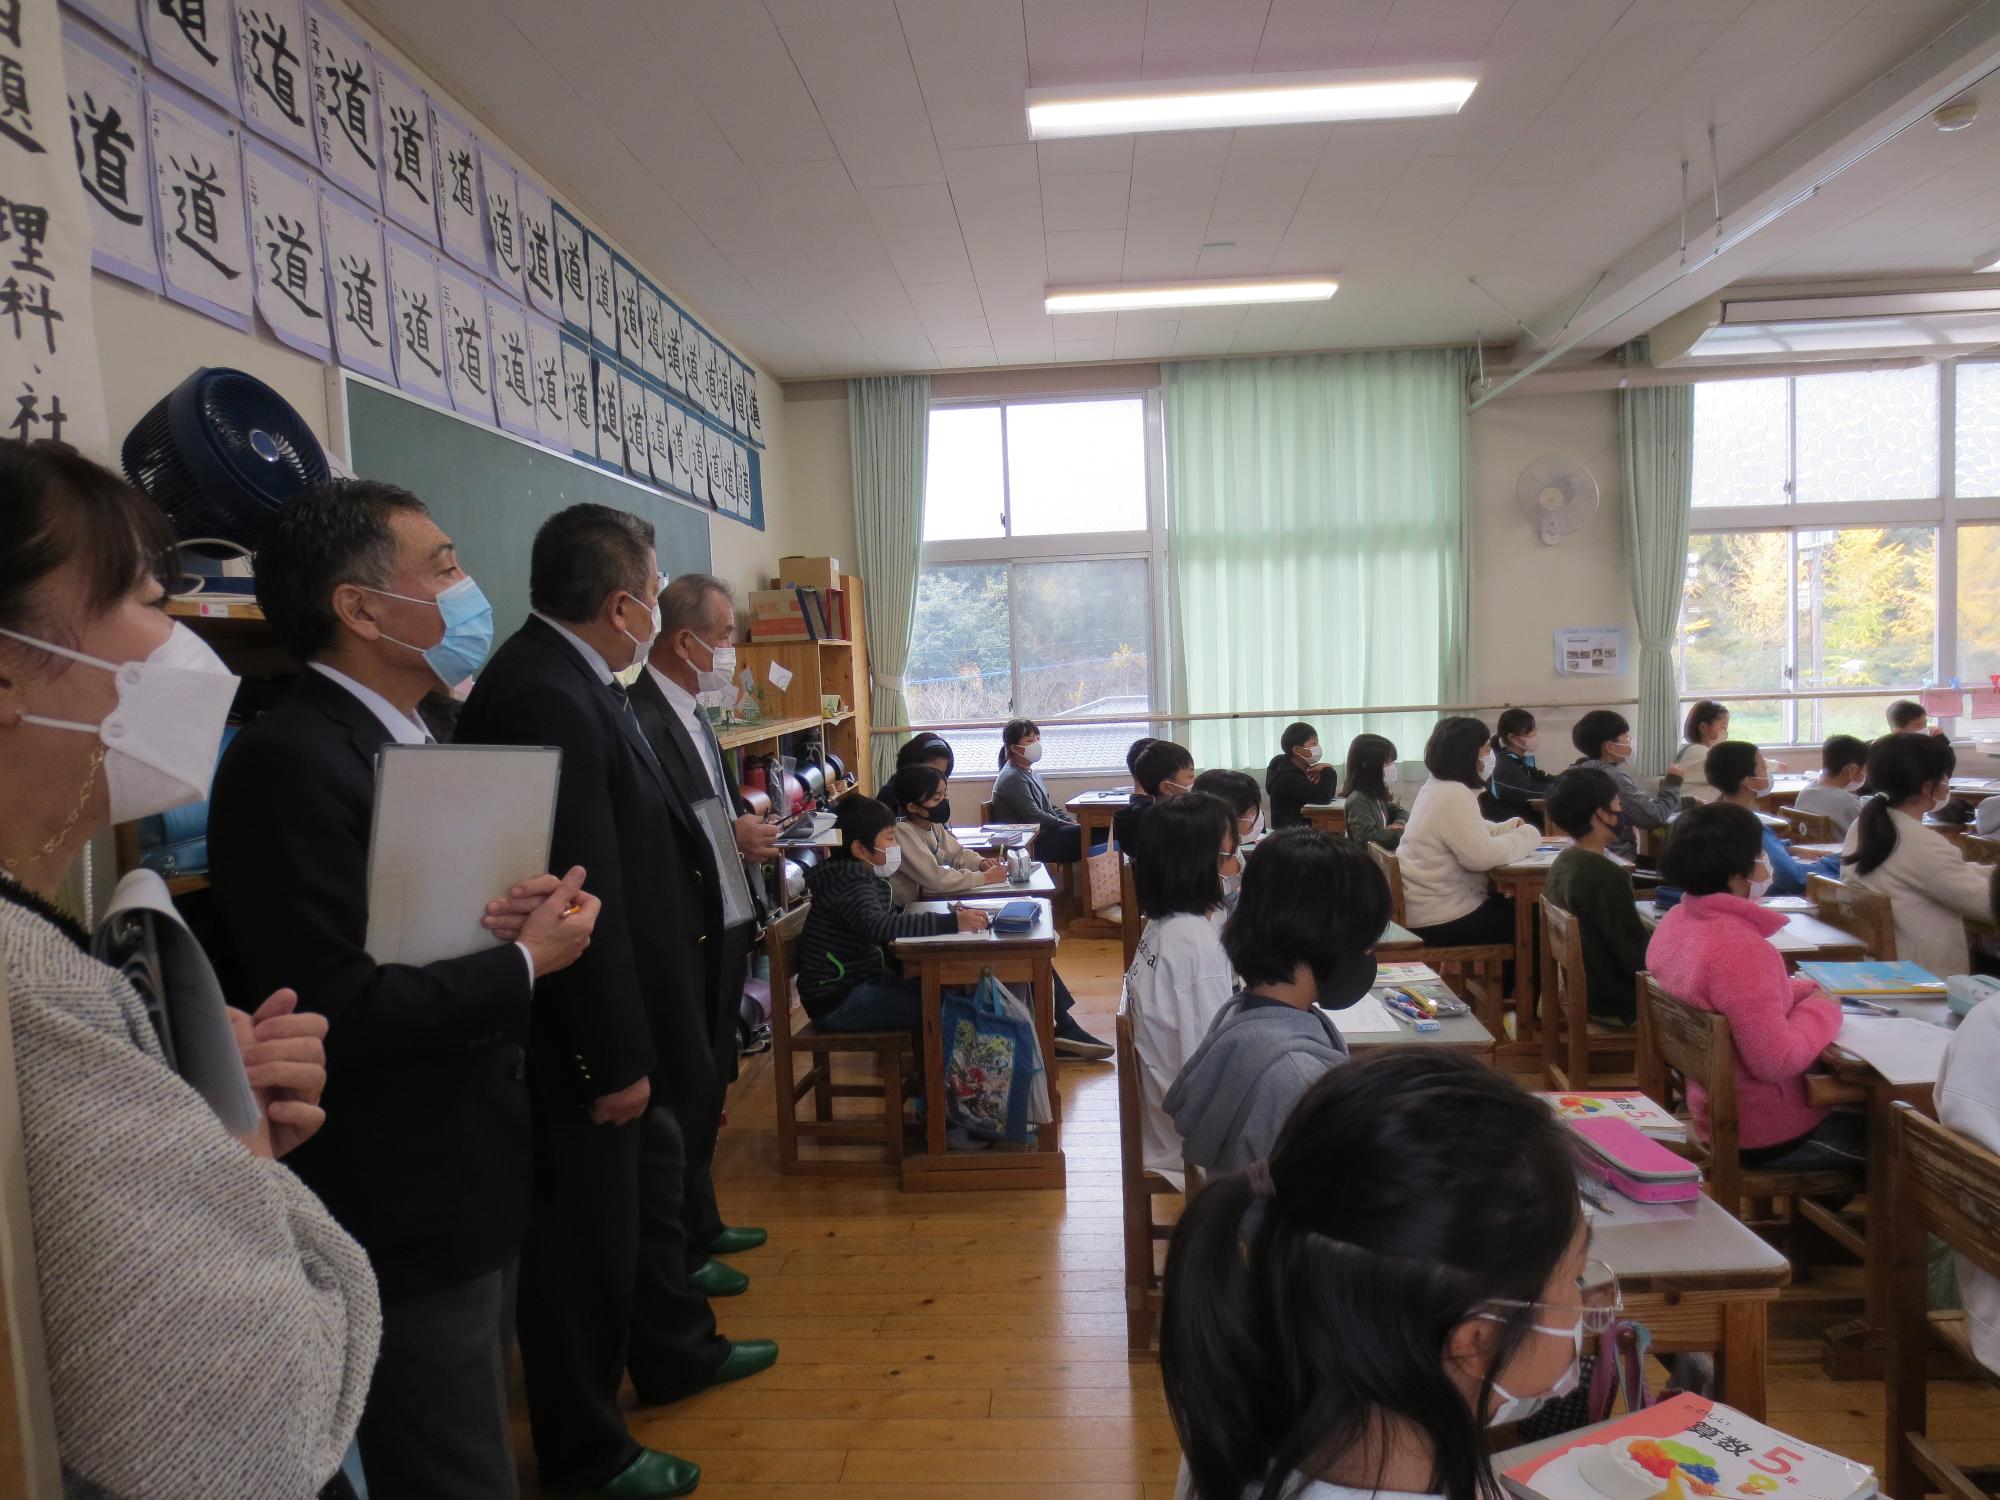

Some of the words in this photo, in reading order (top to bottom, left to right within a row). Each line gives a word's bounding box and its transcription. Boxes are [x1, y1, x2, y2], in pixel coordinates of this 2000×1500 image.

[250, 10, 305, 127] 道
[325, 47, 377, 171] 道
[67, 91, 143, 226] 道
[389, 106, 430, 204] 道
[449, 150, 474, 215] 道
[169, 153, 242, 280] 道
[490, 194, 520, 274] 道
[264, 214, 323, 319] 道
[527, 217, 553, 299] 道
[562, 233, 585, 301] 道
[594, 263, 612, 318] 道
[339, 255, 383, 348] 道
[402, 287, 442, 377] 道
[621, 286, 640, 349] 道
[646, 303, 664, 360] 道
[454, 306, 487, 396] 道
[501, 331, 532, 407] 道
[667, 327, 683, 381] 道
[537, 356, 562, 421] 道
[570, 372, 590, 429] 道
[601, 381, 621, 442] 道
[626, 403, 645, 456] 道
[673, 423, 689, 475] 道
[1682, 1404, 1730, 1426] たのしい
[1685, 1421, 1753, 1457] 算数
